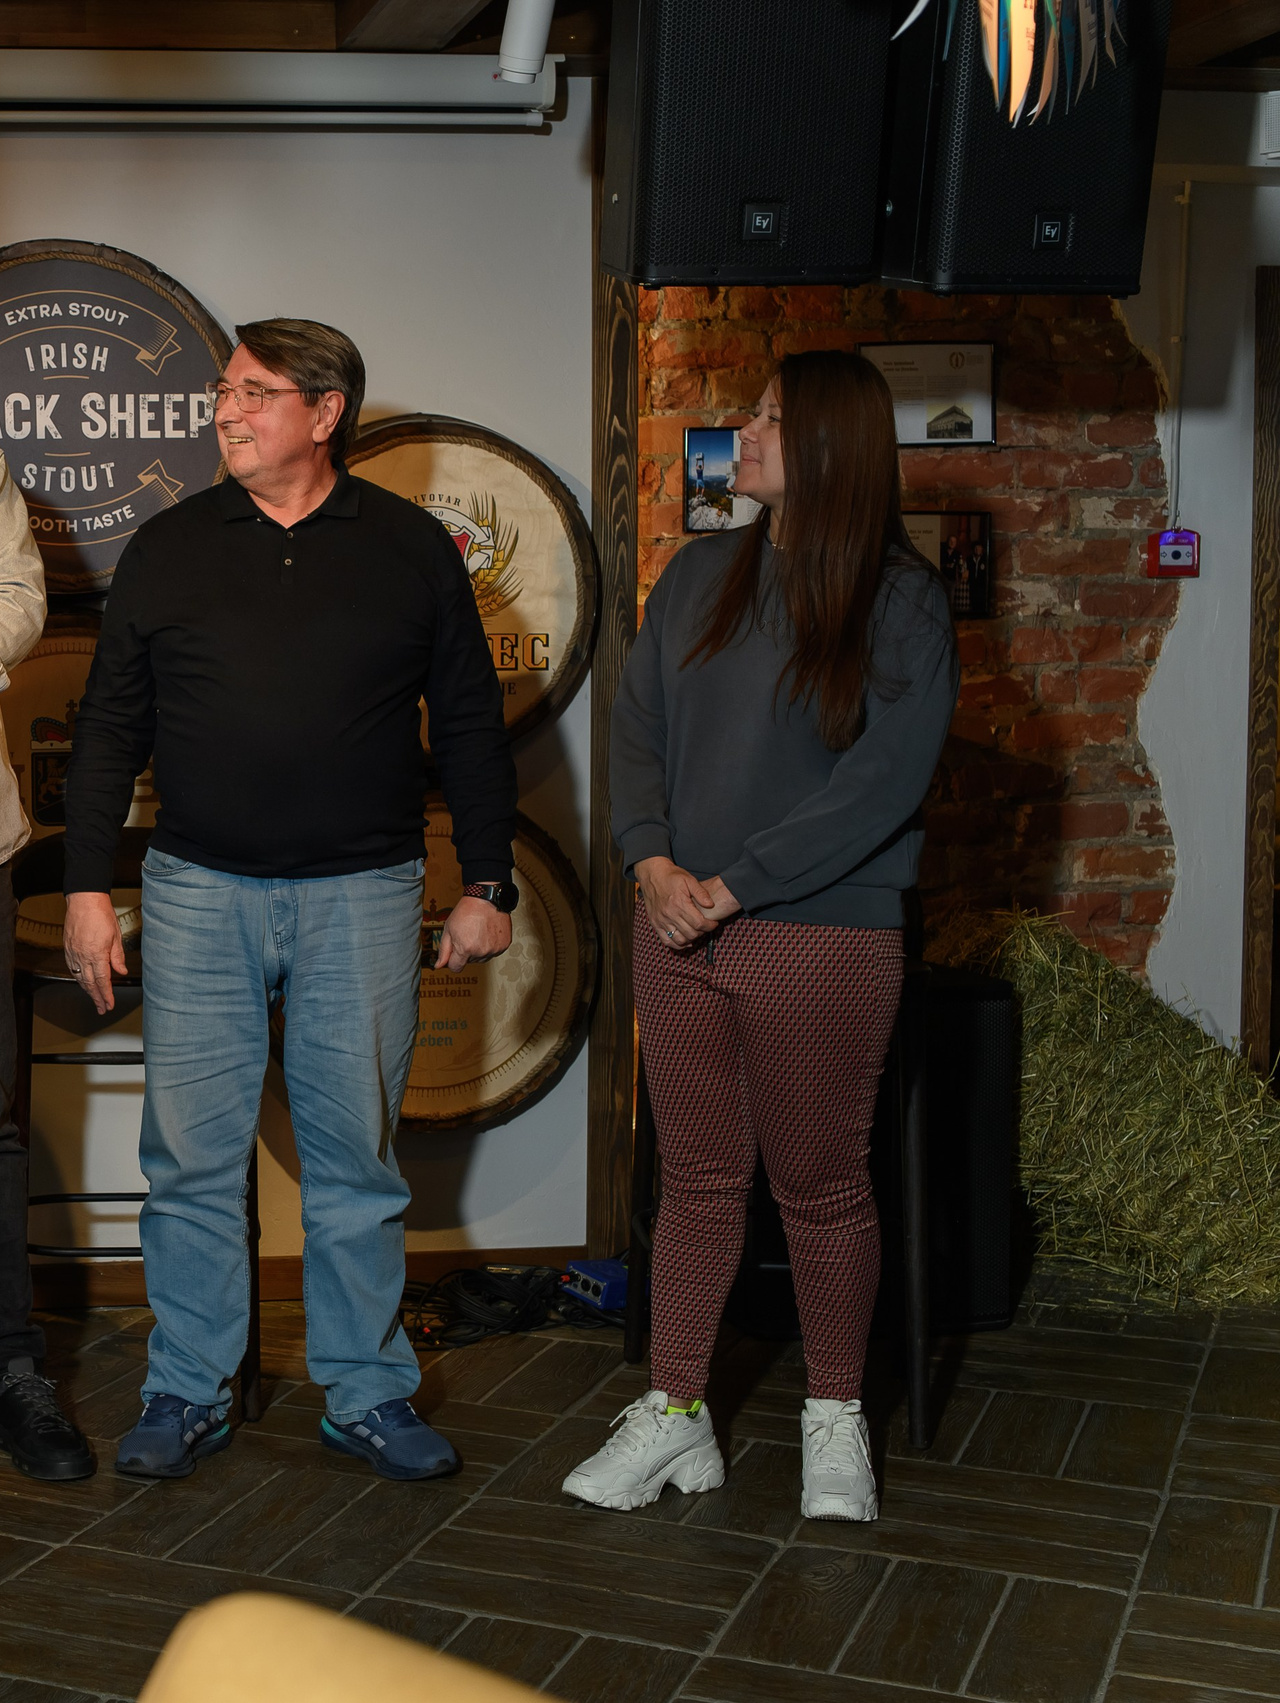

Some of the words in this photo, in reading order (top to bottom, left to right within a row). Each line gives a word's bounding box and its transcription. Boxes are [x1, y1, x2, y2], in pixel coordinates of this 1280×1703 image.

[4, 303, 62, 326] EXTRA
[69, 302, 129, 326] STOUT
[25, 342, 109, 372] IRISH
[81, 392, 214, 439] SHEEP
[21, 462, 115, 493] STOUT
[408, 493, 461, 506] IVOVAR
[28, 515, 78, 533] OOTH
[82, 504, 136, 531] TASTE
[419, 987, 472, 998] unstein
[421, 974, 478, 985] räuhaus
